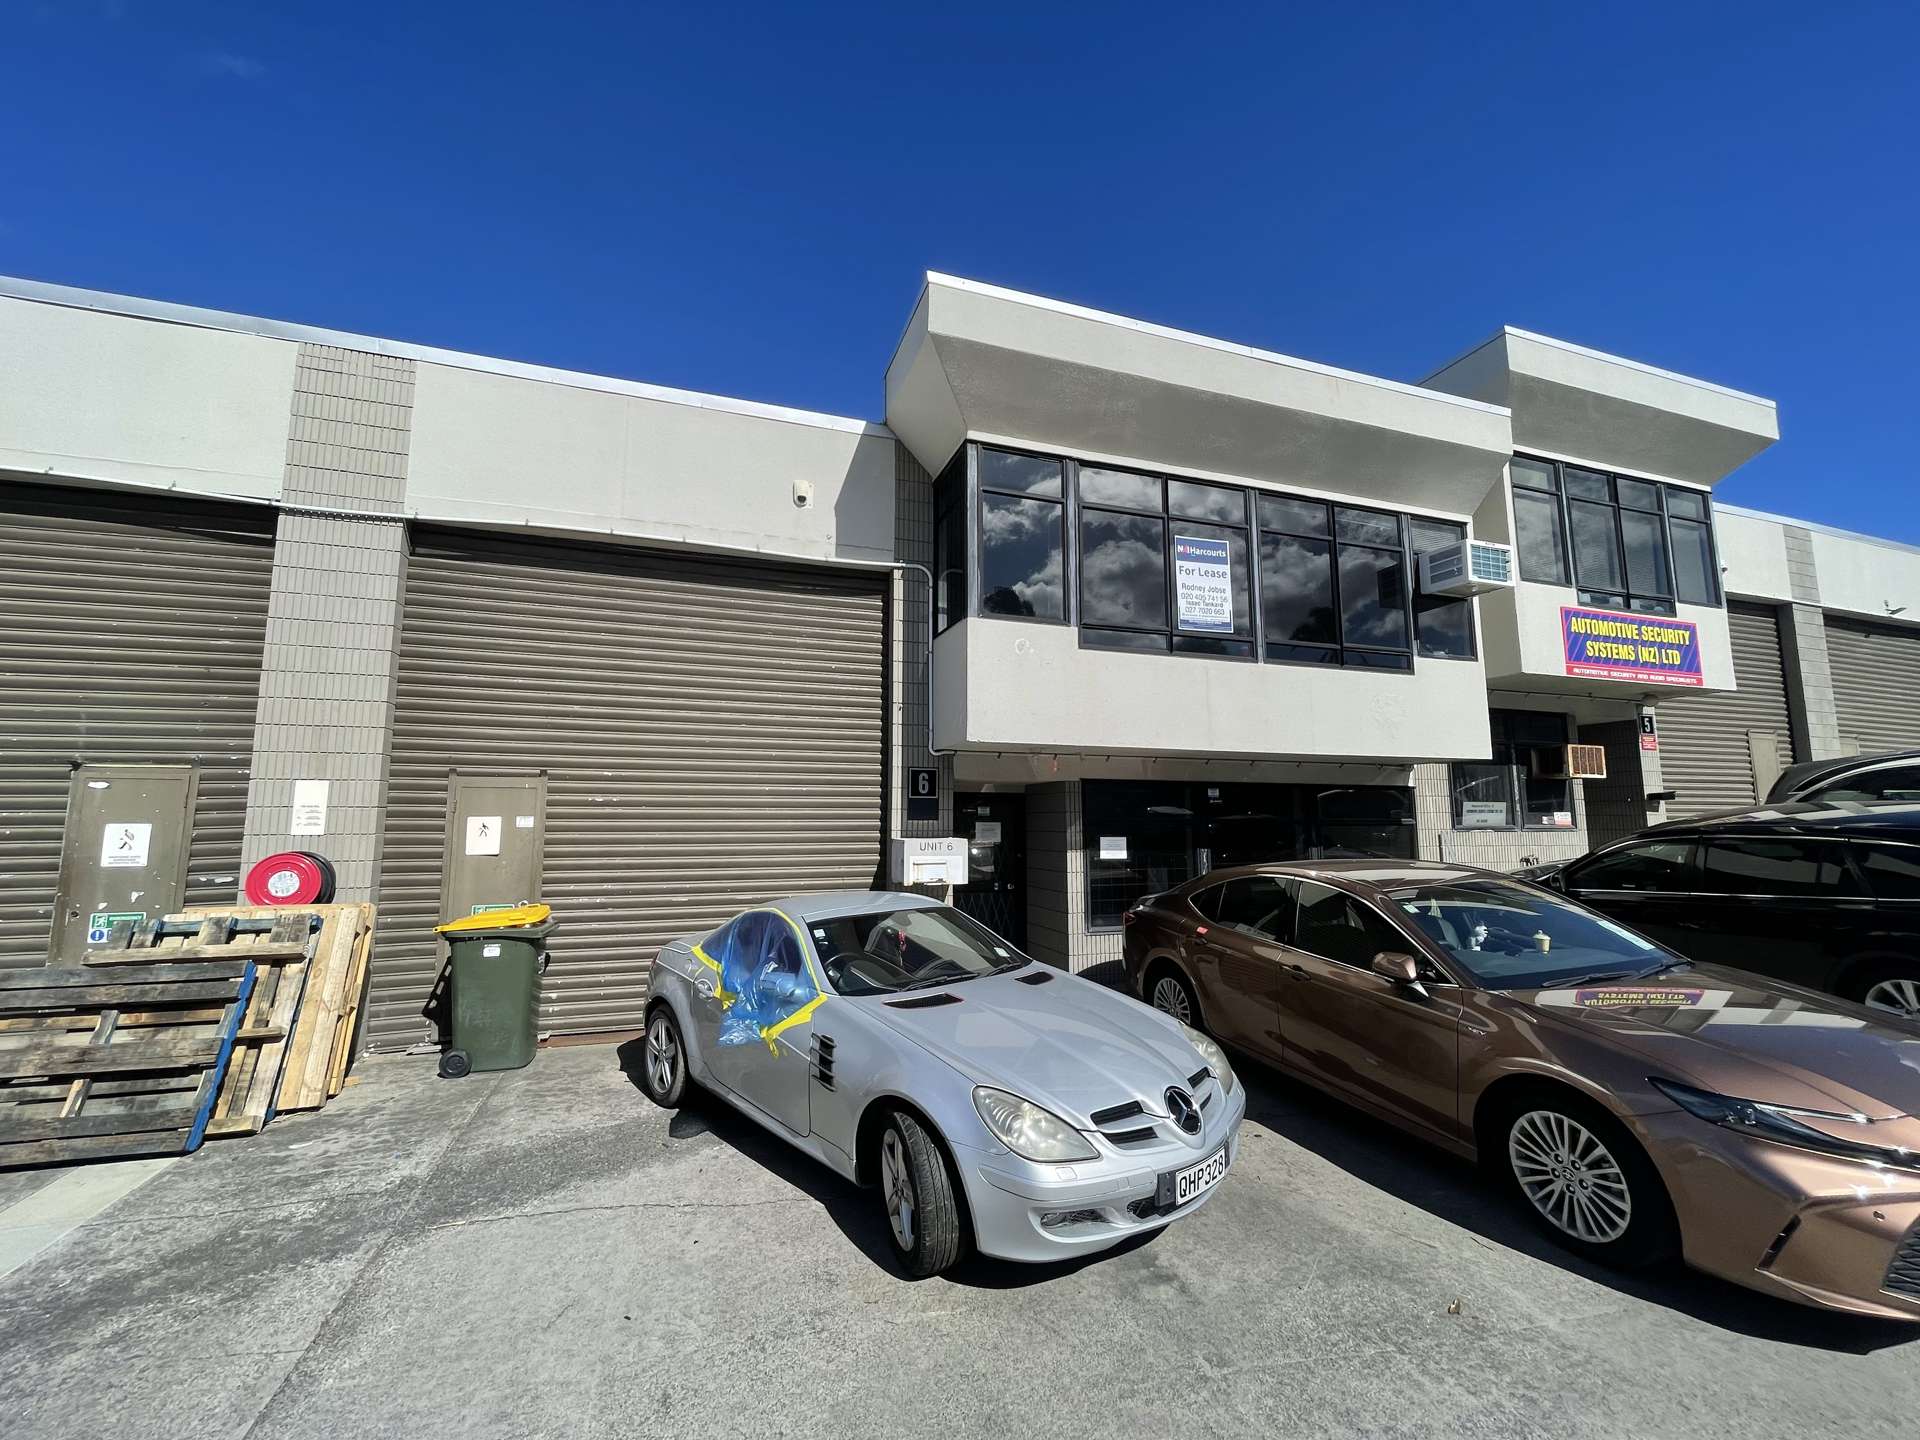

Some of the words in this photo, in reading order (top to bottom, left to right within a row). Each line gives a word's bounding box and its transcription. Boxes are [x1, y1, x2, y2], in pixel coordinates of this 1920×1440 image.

[1190, 546, 1227, 558] Harcourts
[1179, 565, 1195, 576] For
[1198, 567, 1227, 579] Lease
[1181, 582, 1206, 593] Rodney
[1571, 617, 1639, 640] AUTOMOTIVE
[1641, 625, 1690, 646] SECURITY
[1586, 641, 1635, 661] SYSTEMS
[1638, 645, 1659, 664] (NZ)
[1662, 649, 1681, 665] LTD
[1644, 717, 1651, 732] 5
[918, 772, 929, 794] 6
[919, 842, 943, 851] UNIT
[946, 842, 954, 852] 6
[1179, 1154, 1224, 1199] QHP328
